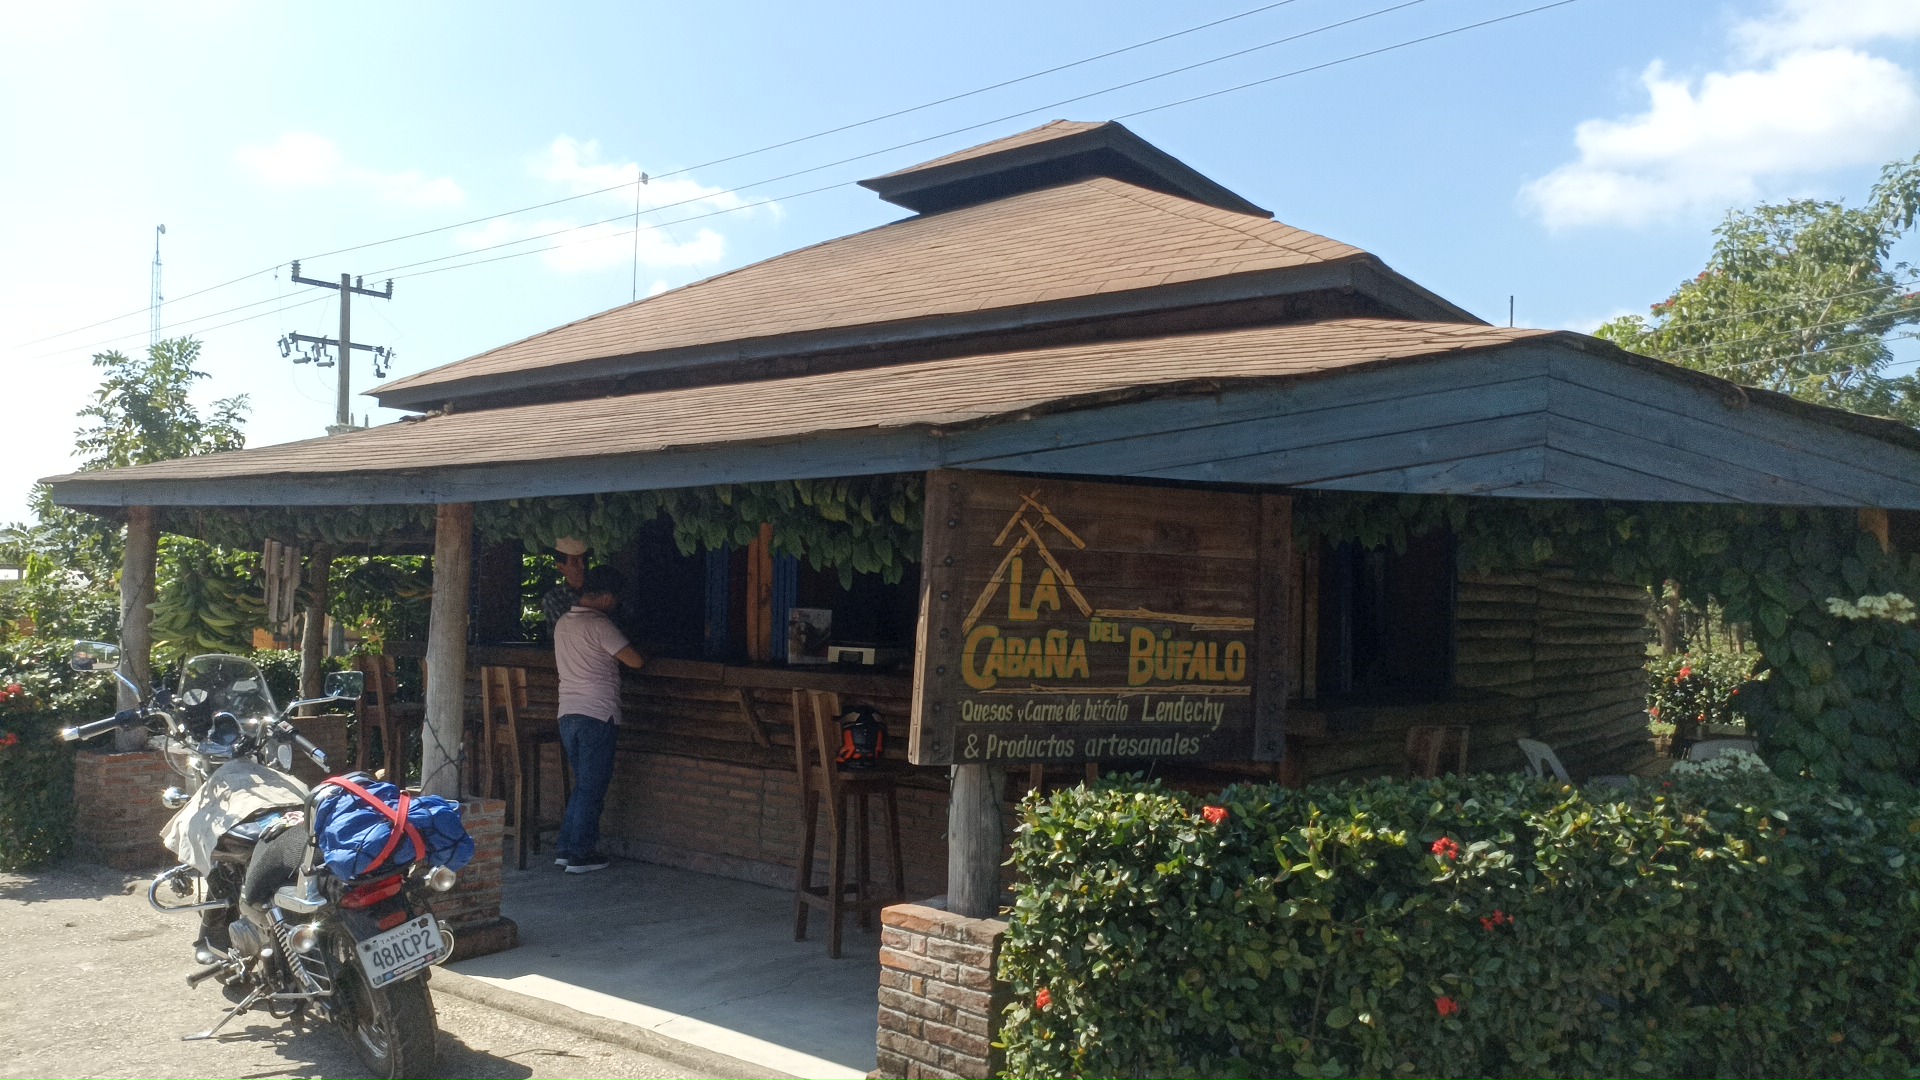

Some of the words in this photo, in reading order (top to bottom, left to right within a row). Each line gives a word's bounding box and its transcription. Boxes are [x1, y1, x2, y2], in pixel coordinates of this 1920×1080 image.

[1008, 557, 1061, 622] LA
[961, 625, 1090, 690] CABAÑA
[1089, 618, 1125, 643] DEL
[1128, 626, 1246, 686] BÚFALO
[1017, 708, 1024, 721] y
[1025, 699, 1063, 722] Carne
[1066, 699, 1081, 721] de
[1084, 698, 1129, 722] búfalo
[1142, 696, 1224, 731] Lendechy
[964, 733, 979, 759] &
[986, 734, 1075, 759] Productos
[372, 929, 436, 970] 48ACP2
[381, 928, 413, 945] TABASCO
